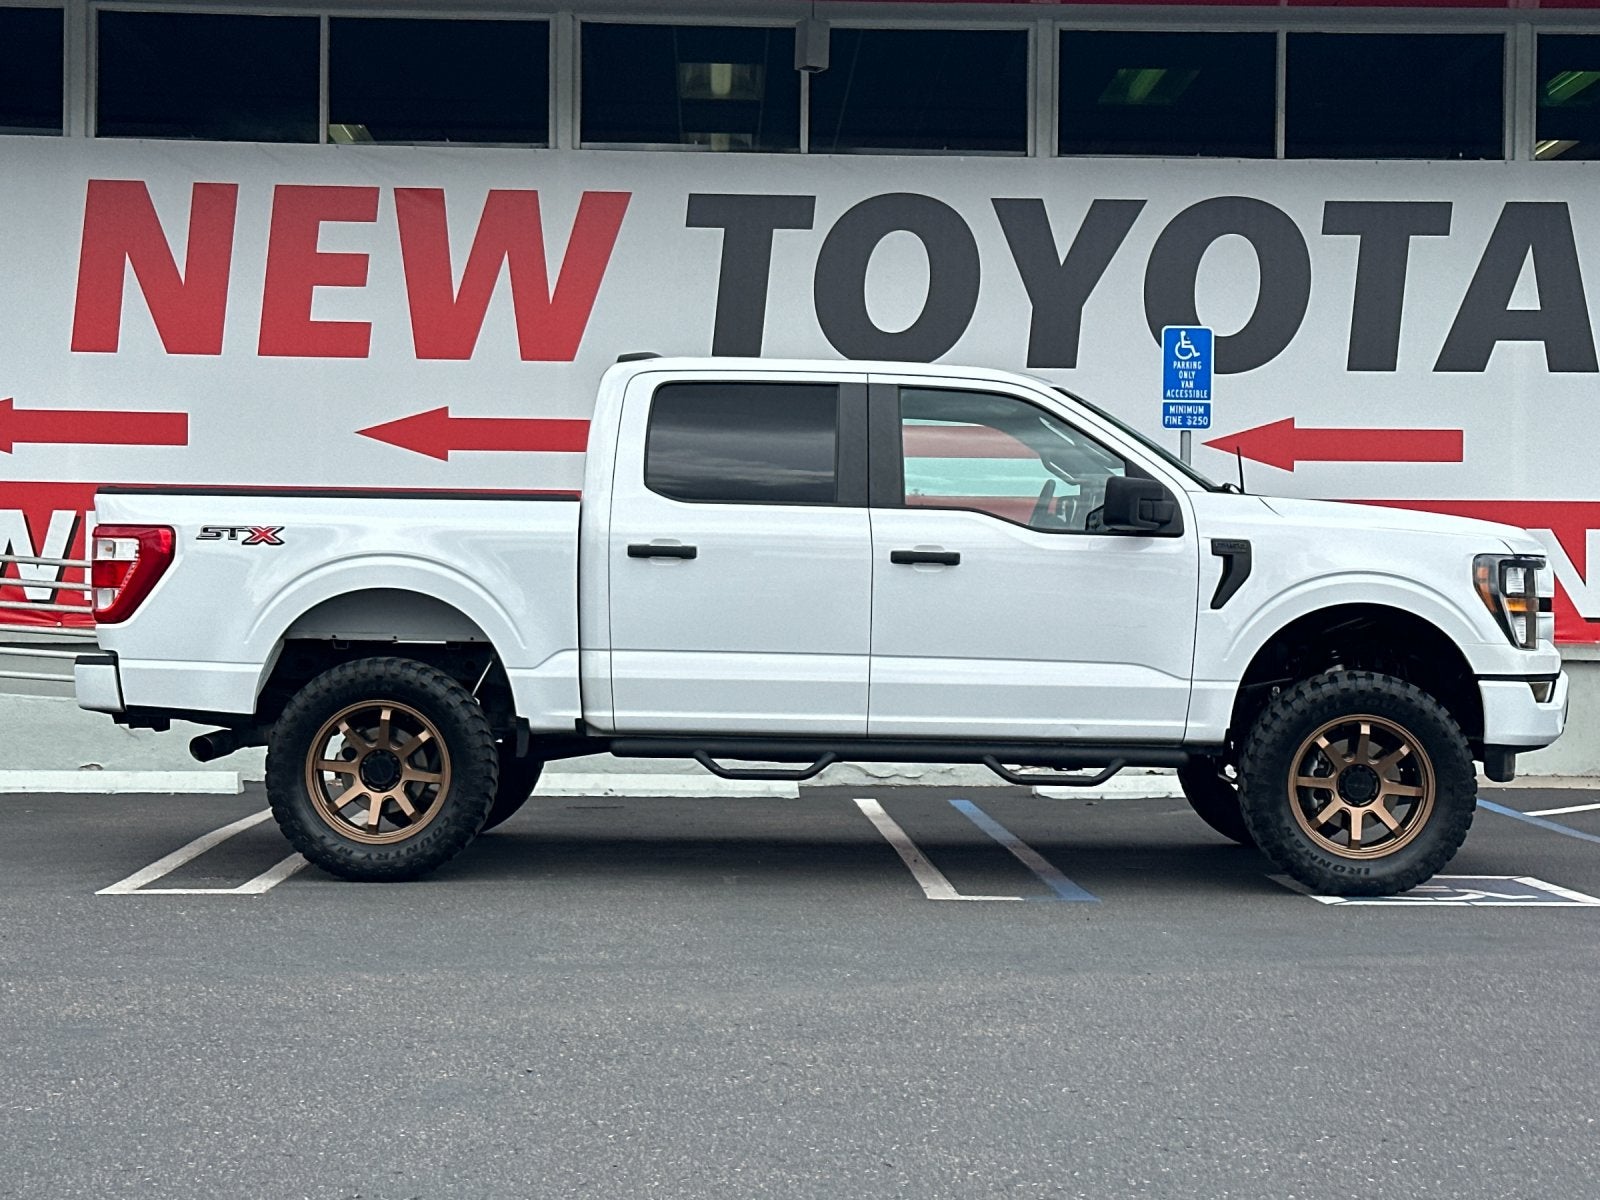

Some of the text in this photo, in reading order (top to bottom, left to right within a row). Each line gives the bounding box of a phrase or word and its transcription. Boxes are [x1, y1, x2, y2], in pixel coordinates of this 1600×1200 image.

[71, 179, 1599, 374] NEW TOYOTA
[1173, 361, 1202, 369] PARKING
[1179, 371, 1196, 379] ONLY
[1166, 390, 1208, 398] ACCESSIBLE
[1170, 406, 1204, 414] MINIMUM
[1165, 416, 1208, 425] FINE $250
[196, 525, 285, 545] STX
[1286, 827, 1371, 876] IRONMAN
